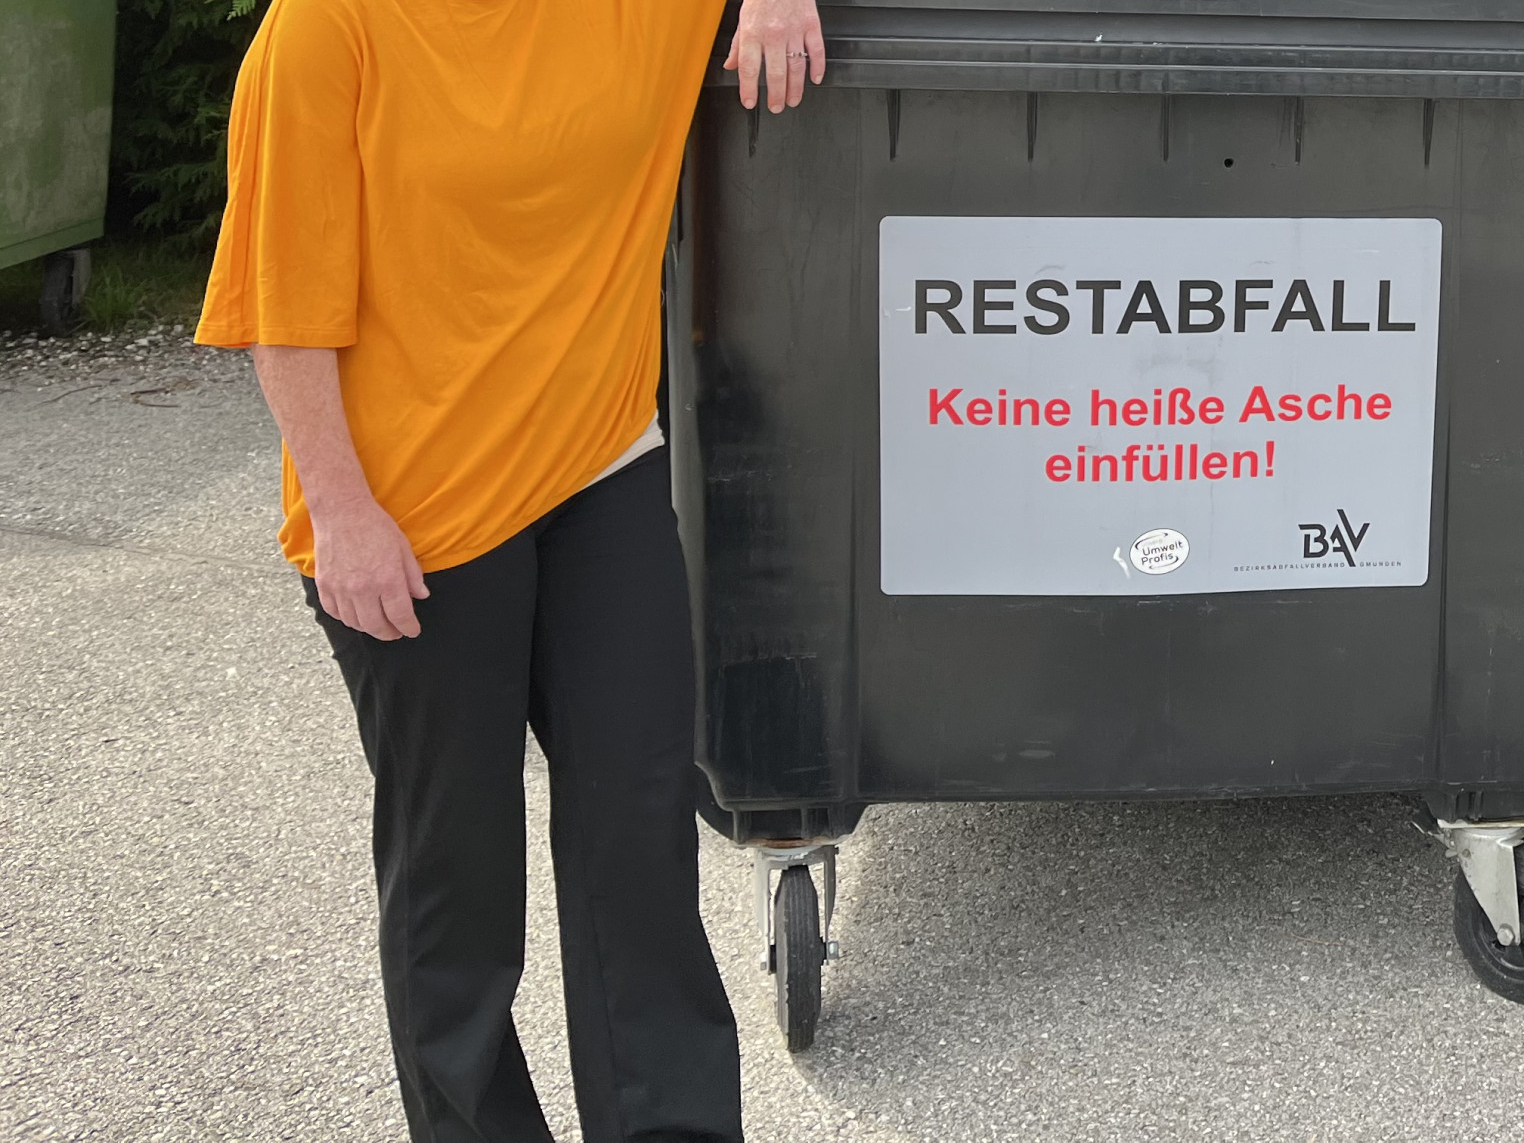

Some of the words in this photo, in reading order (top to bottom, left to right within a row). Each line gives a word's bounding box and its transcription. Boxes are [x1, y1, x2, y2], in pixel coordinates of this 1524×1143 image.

[914, 278, 1417, 336] RESTABFALL
[928, 388, 1072, 426] Keine
[1090, 388, 1226, 427] heiße
[1239, 385, 1393, 423] Asche
[1044, 441, 1276, 483] einfüllen!
[1141, 552, 1174, 566] Profis
[1142, 540, 1183, 556] Umwelt
[1297, 508, 1371, 568] BAV
[1233, 562, 1346, 572] BEZIRKSABFALLVERBAND
[1359, 560, 1403, 568] GMUNDEN
